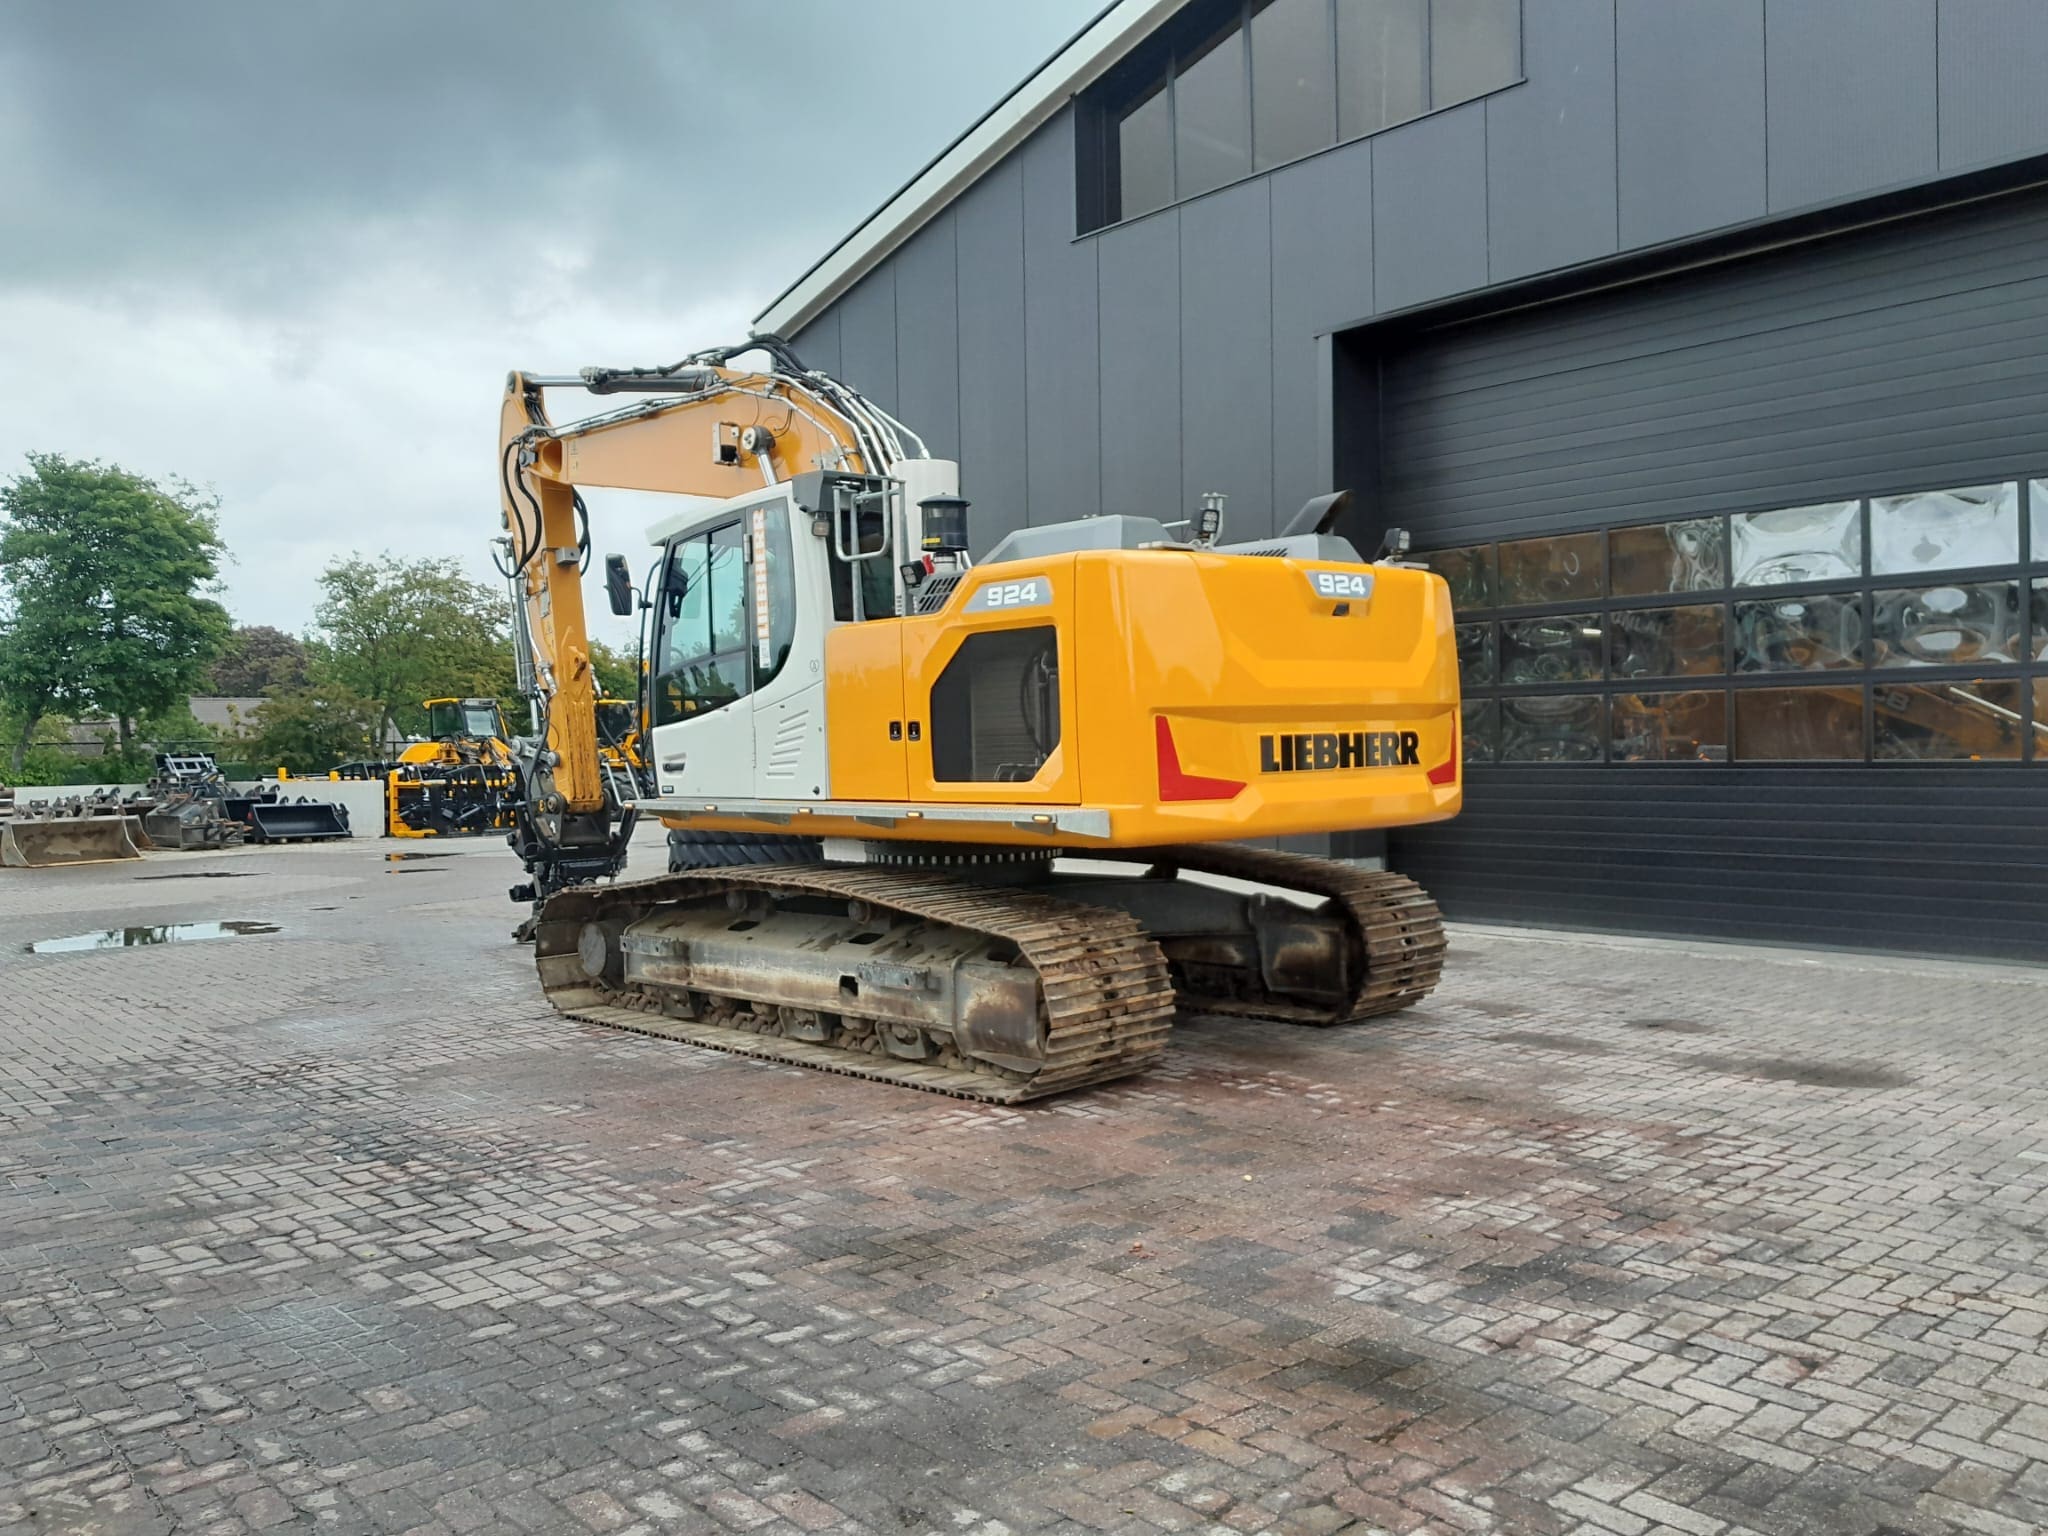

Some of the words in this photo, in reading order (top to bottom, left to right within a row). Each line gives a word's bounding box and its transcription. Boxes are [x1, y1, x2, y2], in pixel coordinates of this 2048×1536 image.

[752, 508, 770, 639] LIEBHERR
[1318, 573, 1366, 595] 924
[986, 582, 1038, 606] 924
[1260, 731, 1420, 772] LIEBHERR
